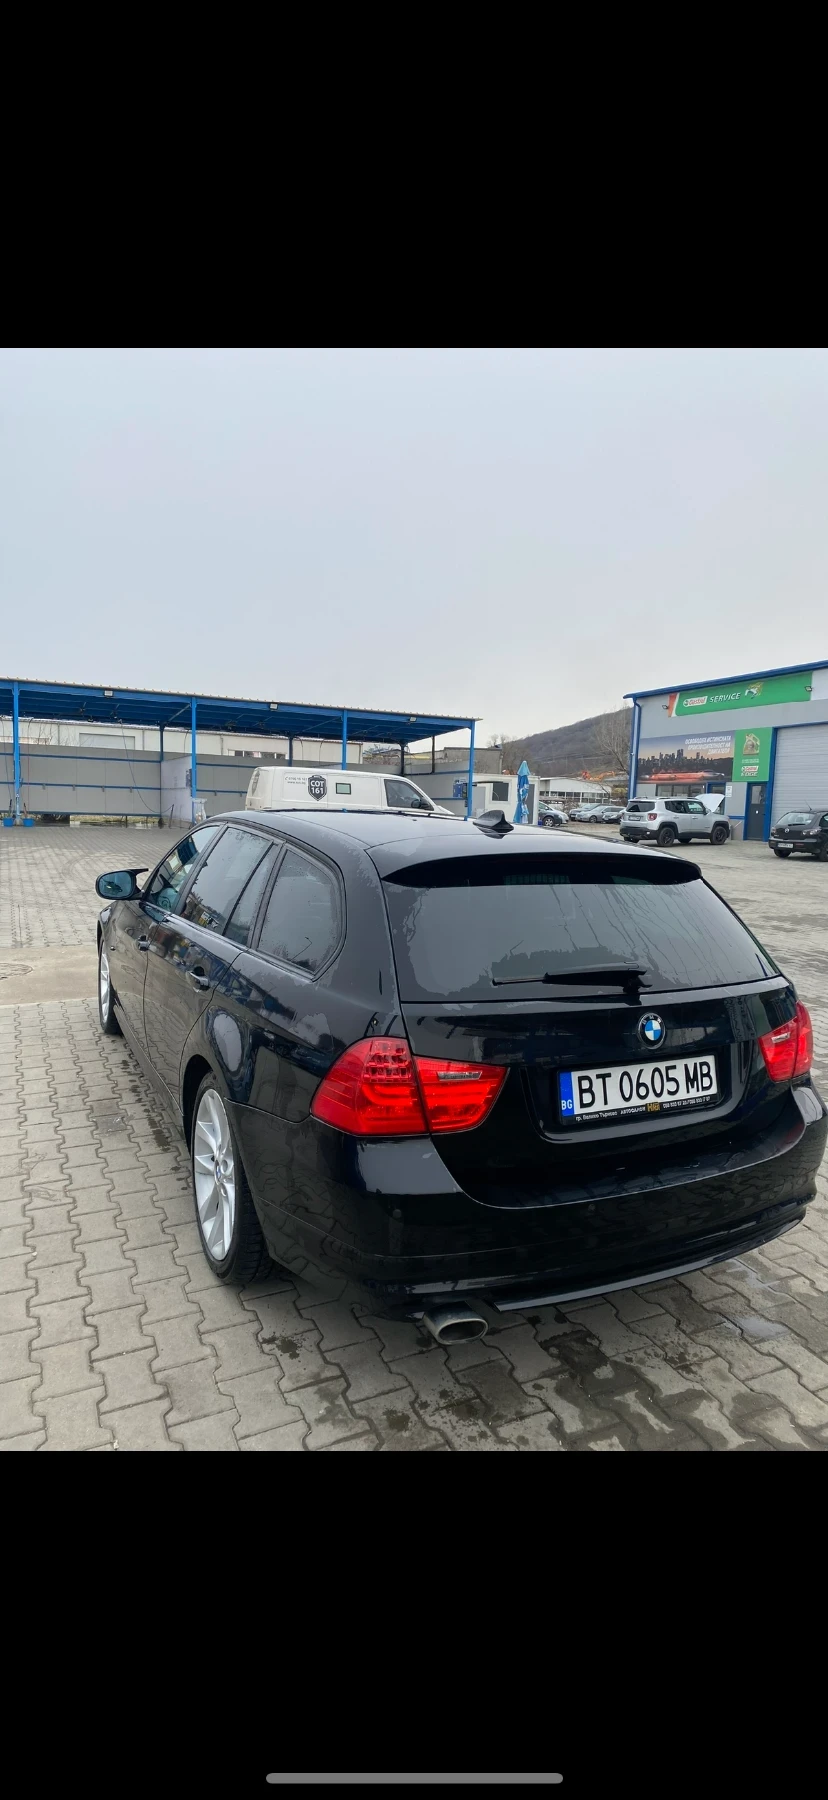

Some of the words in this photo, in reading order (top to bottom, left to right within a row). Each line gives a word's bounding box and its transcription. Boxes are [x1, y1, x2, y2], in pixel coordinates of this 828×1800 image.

[709, 692, 741, 703] SERVICE
[577, 1072, 612, 1109] BT
[619, 1064, 680, 1102] 0605
[684, 1060, 713, 1094] MB
[561, 1099, 573, 1111] BG
